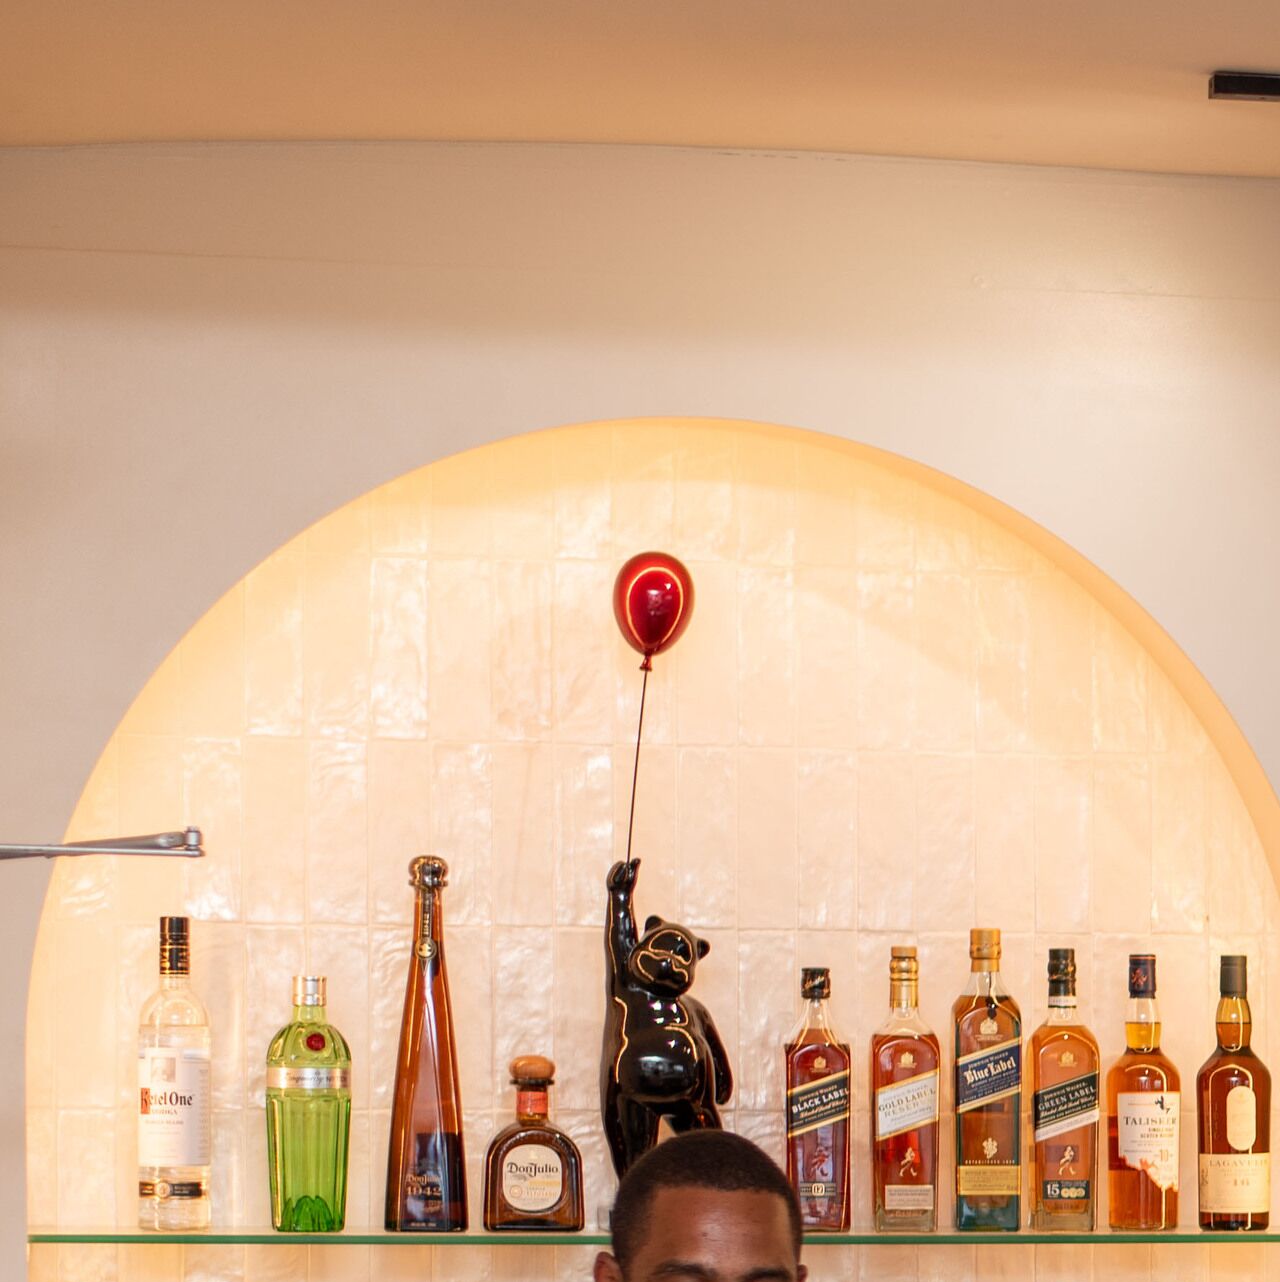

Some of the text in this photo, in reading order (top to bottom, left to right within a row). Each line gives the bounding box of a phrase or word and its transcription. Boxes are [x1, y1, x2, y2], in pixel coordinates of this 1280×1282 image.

[964, 1057, 1016, 1084] Blue Label
[169, 1091, 194, 1106] One
[792, 1087, 850, 1114] BLACK LABEL
[878, 1088, 936, 1112] GOLD LABEL
[1038, 1087, 1096, 1111] GREEN LABEL
[1046, 1183, 1060, 1197] 15
